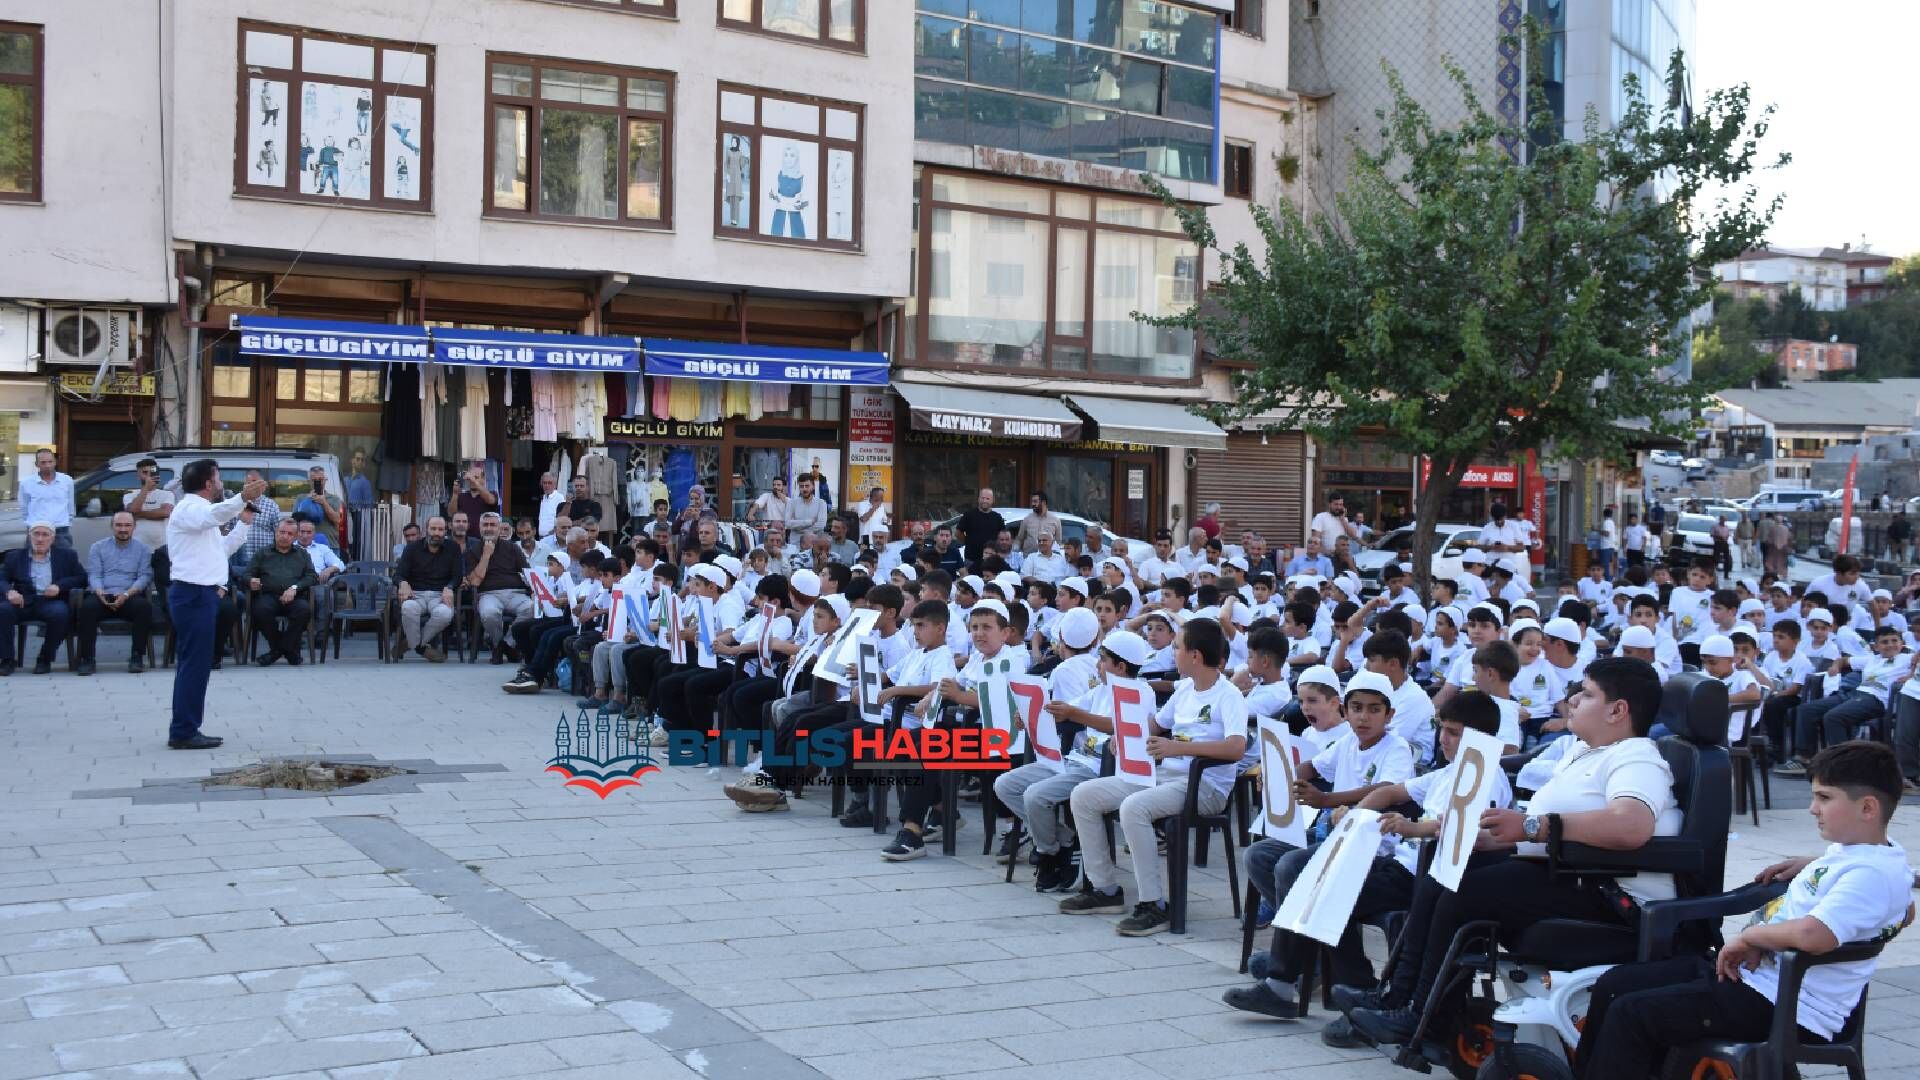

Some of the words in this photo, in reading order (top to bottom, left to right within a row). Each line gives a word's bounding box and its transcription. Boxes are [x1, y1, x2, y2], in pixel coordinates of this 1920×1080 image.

[447, 345, 534, 364] GÜÇLÜ
[547, 351, 624, 367] GİYİM
[684, 360, 760, 377] GÜÇLÜ
[784, 364, 852, 380] GİYİM
[931, 413, 992, 434] KAYMAZ
[1003, 420, 1062, 439] KUNDURA
[859, 643, 882, 715] E
[1009, 681, 1062, 762] Z
[1112, 684, 1152, 777] E
[1261, 727, 1296, 829] D
[1440, 746, 1485, 866] R
